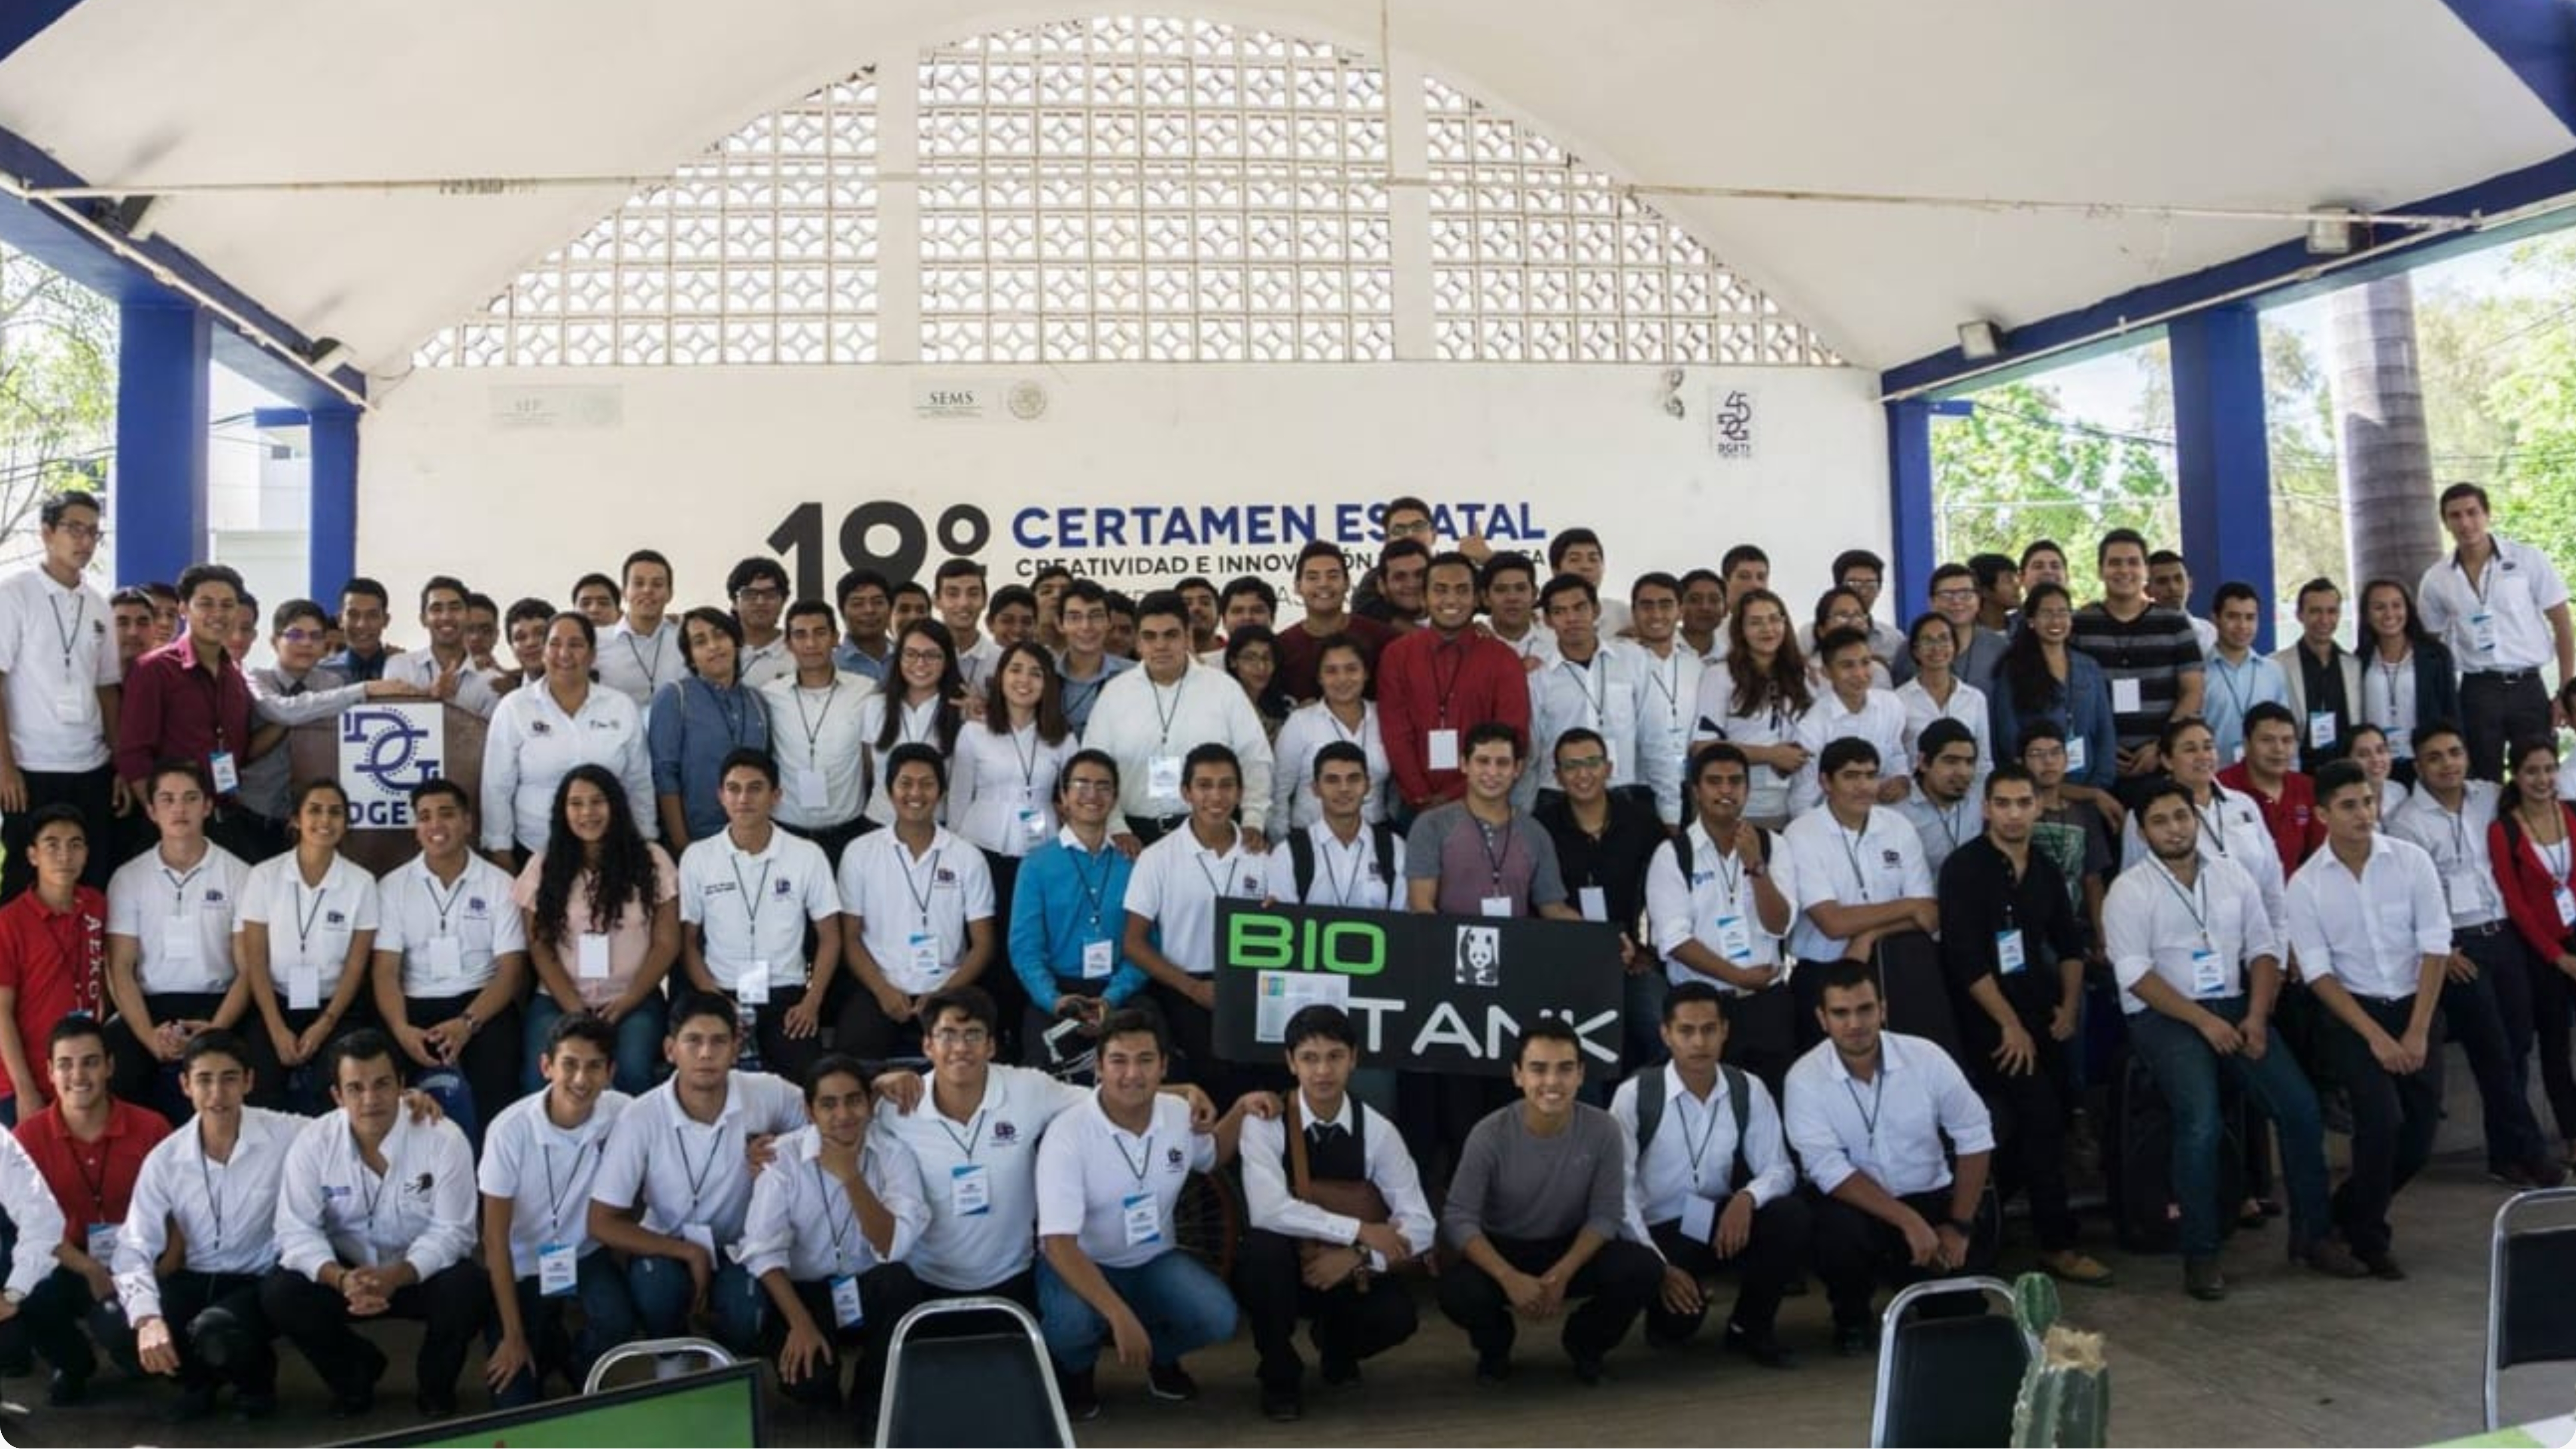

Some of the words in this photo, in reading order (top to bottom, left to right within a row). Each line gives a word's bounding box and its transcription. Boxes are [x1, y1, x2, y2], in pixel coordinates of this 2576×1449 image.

[930, 390, 974, 405] SEMS
[1012, 505, 1315, 549] CERTAMEN
[1336, 502, 1546, 543] ESATAL
[1197, 556, 1211, 574] E
[1229, 913, 1386, 975] BIO
[1348, 997, 1619, 1064] TANK
